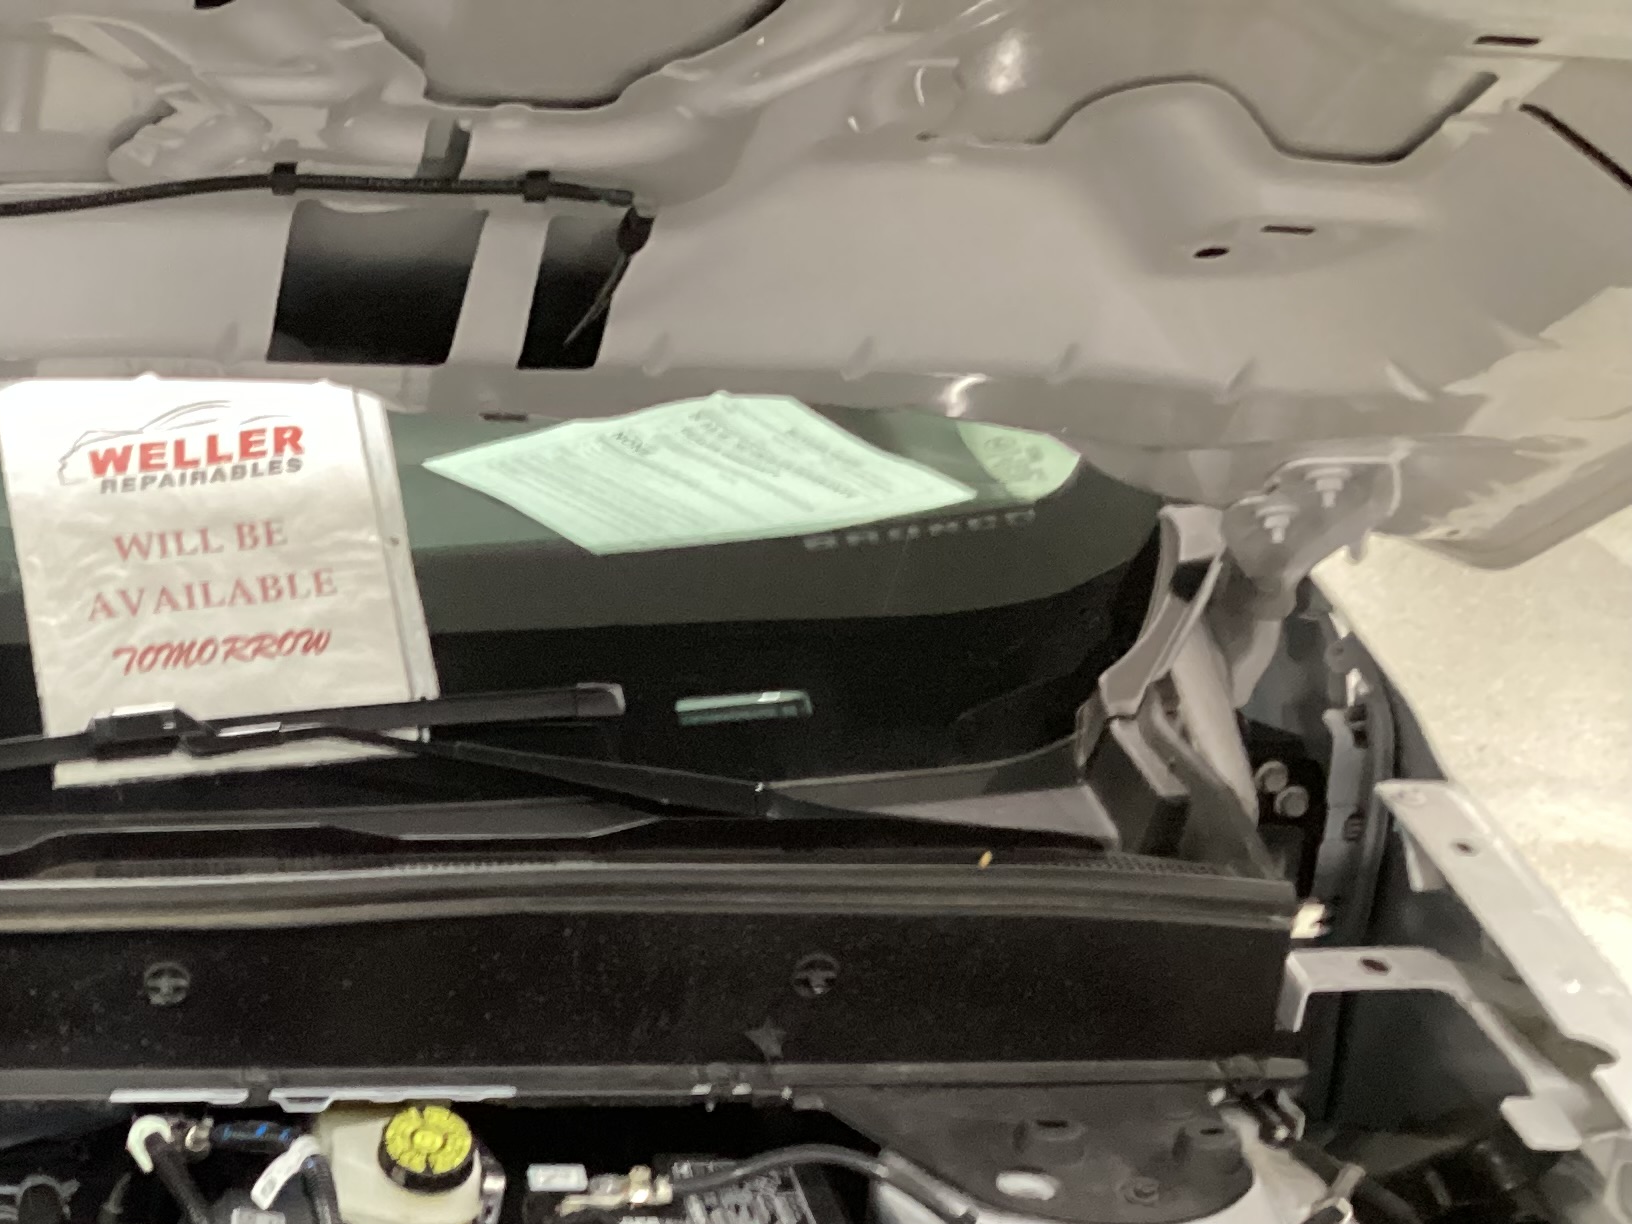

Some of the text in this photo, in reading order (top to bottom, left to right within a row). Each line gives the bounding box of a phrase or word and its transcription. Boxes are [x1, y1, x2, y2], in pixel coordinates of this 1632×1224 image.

[88, 425, 305, 478] WELLER
[99, 457, 304, 494] REPAIRABLES
[113, 516, 289, 562] WILL BE
[87, 567, 338, 622] AVAILABLE
[112, 628, 333, 676] TOMORROW
